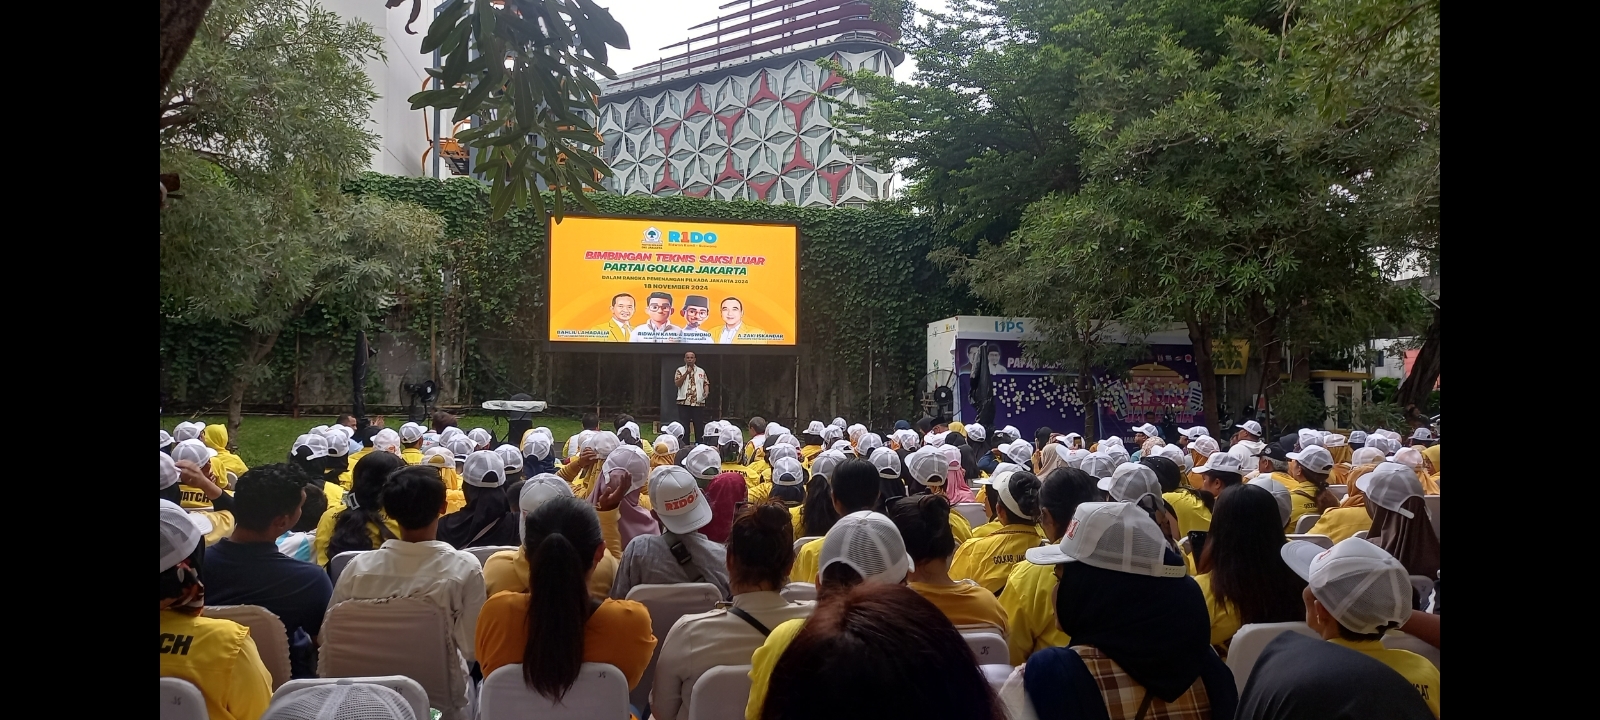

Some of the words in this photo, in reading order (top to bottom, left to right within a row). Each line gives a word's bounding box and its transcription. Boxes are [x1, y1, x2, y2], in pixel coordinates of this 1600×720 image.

[668, 231, 717, 244] R1DO
[585, 251, 652, 261] BIMBINGAN
[656, 253, 696, 263] TEKNIS
[699, 255, 733, 265] SAKSI
[736, 256, 766, 265] LUAR
[603, 262, 646, 272] PARTAI
[647, 264, 694, 273] GOLKAR
[695, 265, 747, 275] JAKARTA
[994, 320, 1024, 333] UPS
[1125, 405, 1194, 423] JAKATA
[181, 491, 210, 503] ATCH
